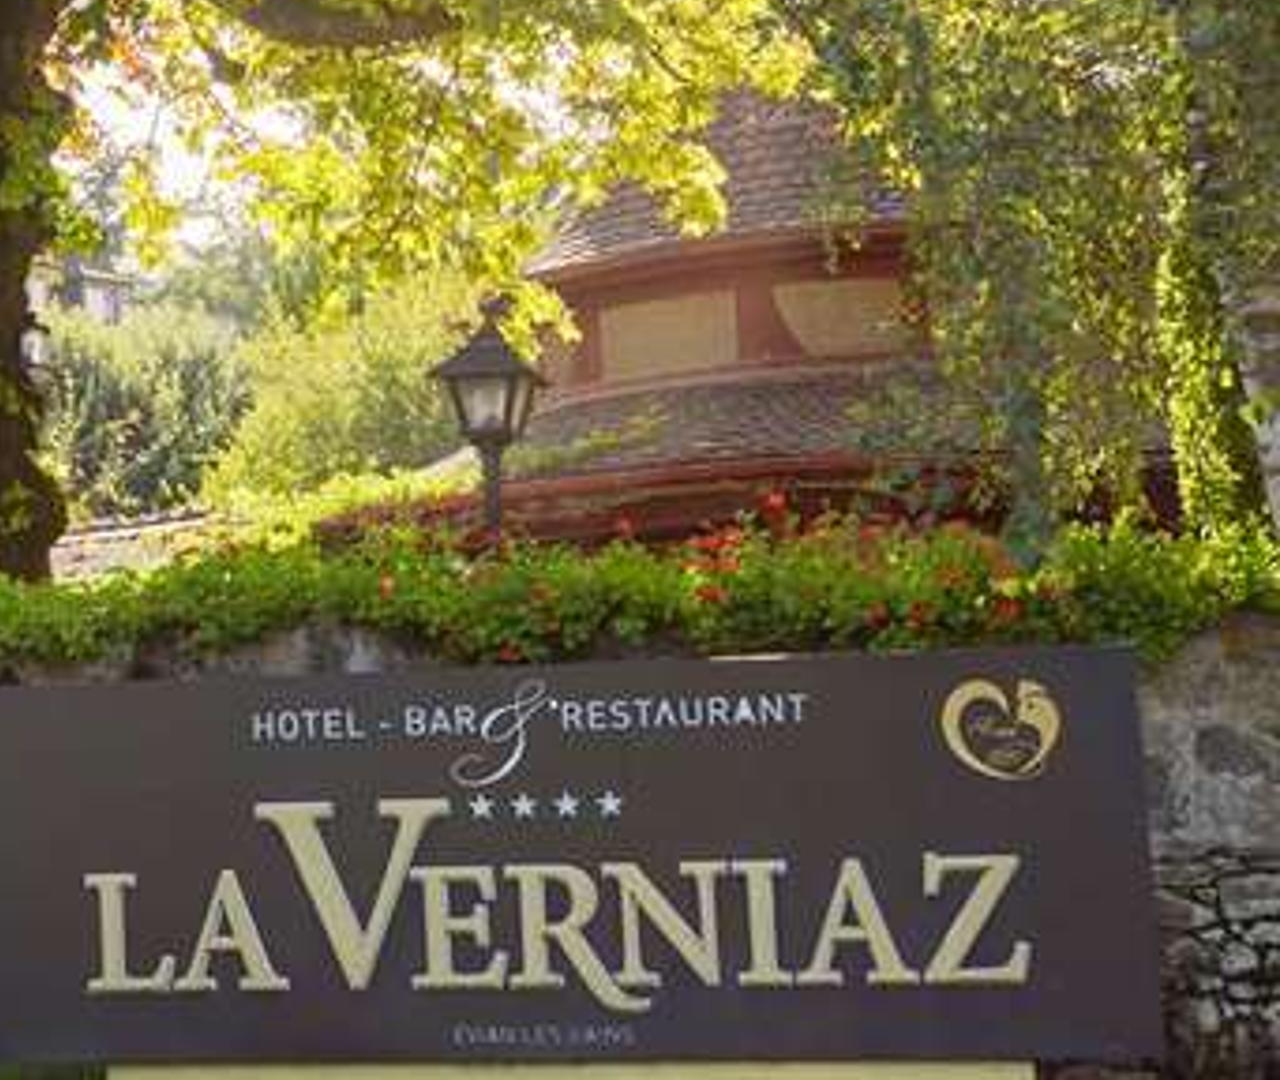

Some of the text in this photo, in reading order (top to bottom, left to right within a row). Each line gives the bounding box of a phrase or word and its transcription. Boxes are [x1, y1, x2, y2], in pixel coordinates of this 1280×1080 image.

[252, 709, 366, 742] HOTEL
[404, 704, 477, 736] BAR
[561, 693, 808, 731] RESTAURANT
[84, 798, 1034, 1011] LA VERNIAZ
